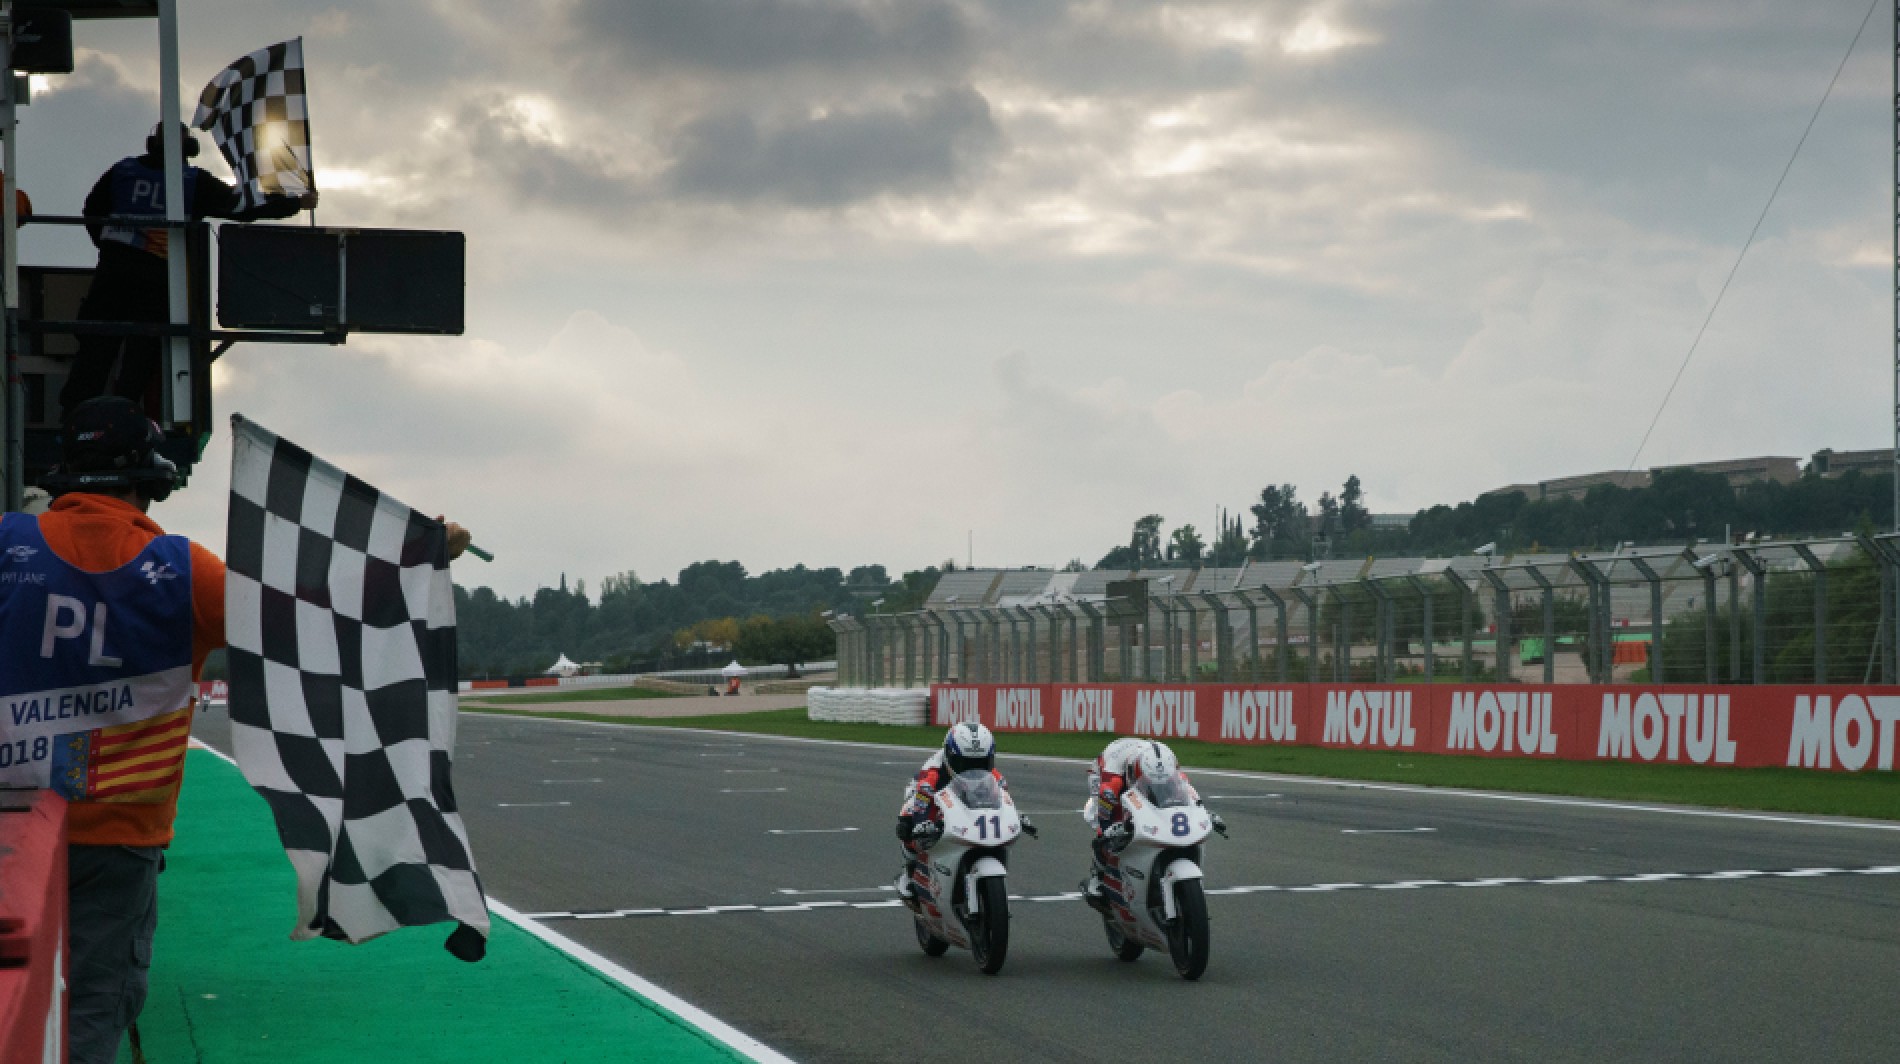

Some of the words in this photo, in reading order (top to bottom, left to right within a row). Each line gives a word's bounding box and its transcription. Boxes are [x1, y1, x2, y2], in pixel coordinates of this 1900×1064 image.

[131, 179, 164, 210] PL
[40, 593, 123, 668] PL
[10, 684, 134, 726] VALENCIA
[937, 688, 980, 723] MOTUL
[995, 688, 1044, 728] MOTUL
[1059, 688, 1115, 732] MOTUL
[1134, 689, 1199, 736] MOTUL
[1220, 690, 1297, 740] MOTUL
[1323, 690, 1416, 746] MOTUL
[1446, 691, 1558, 754] MOTUL
[1598, 692, 1736, 763] MOTUL
[0, 736, 48, 768] 018
[974, 815, 1001, 839] 11
[1170, 812, 1190, 837] 8
